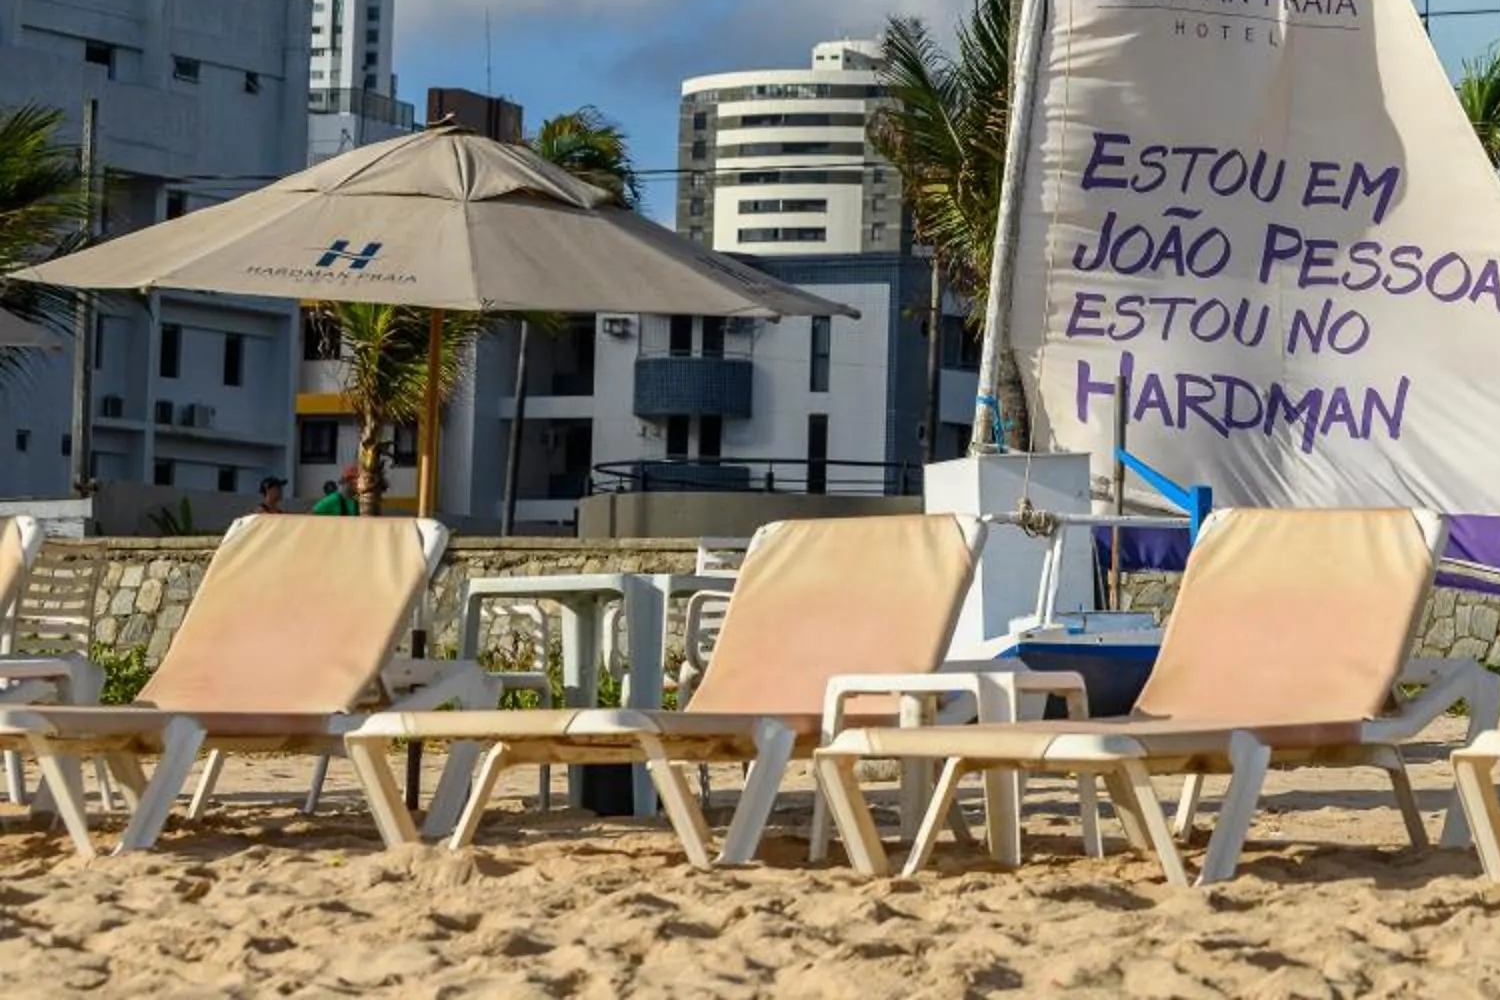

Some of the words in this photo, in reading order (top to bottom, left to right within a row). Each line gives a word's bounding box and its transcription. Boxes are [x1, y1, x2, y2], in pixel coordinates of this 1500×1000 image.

[1174, 18, 1279, 47] HOTEL
[1081, 131, 1286, 203] ESTOU
[1302, 161, 1401, 225] EM
[246, 265, 350, 280] HARDMAN
[357, 272, 418, 284] PRAIA
[1072, 207, 1231, 279] JOÃO
[1066, 292, 1270, 348] ESTOU
[1287, 299, 1371, 355] NO
[1077, 351, 1410, 454] HARDMAN
